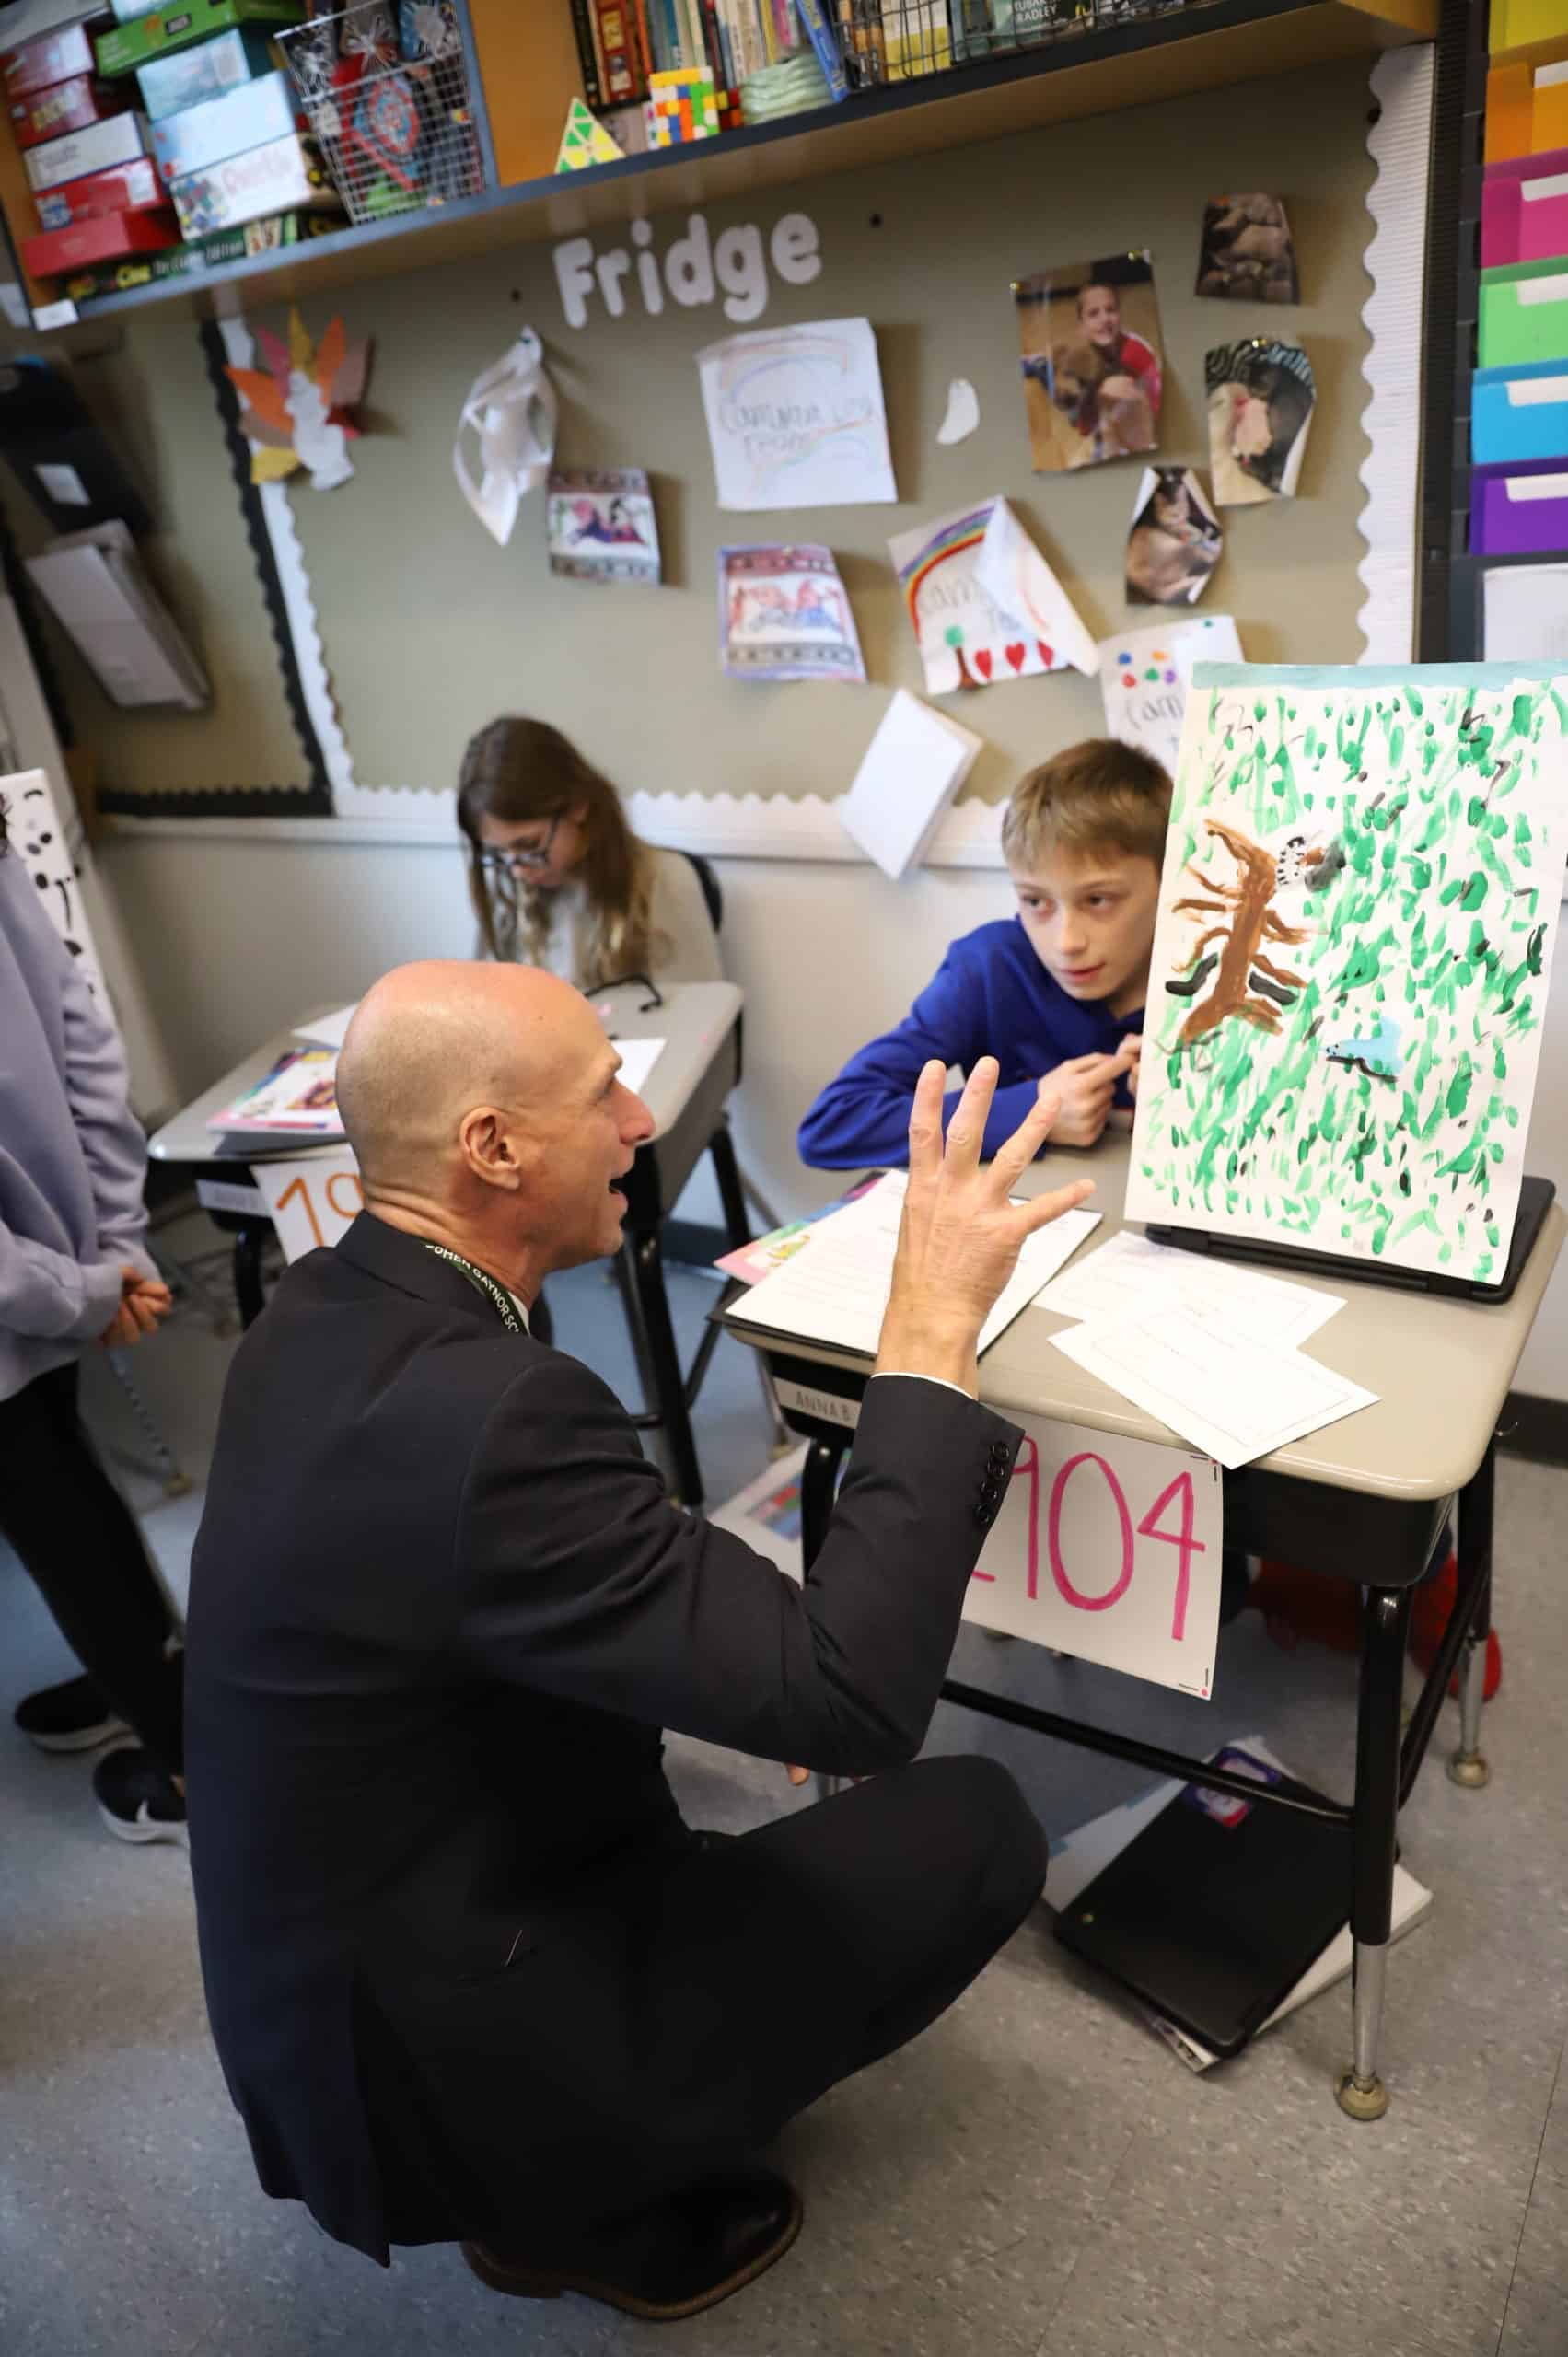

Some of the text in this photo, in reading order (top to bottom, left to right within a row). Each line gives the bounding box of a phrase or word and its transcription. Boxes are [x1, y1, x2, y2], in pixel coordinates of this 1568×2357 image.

[1016, 5, 1059, 23] RADLEY
[554, 212, 822, 329] Fridge
[425, 1244, 520, 1334] OHEN GAYNOR SC
[972, 1435, 1206, 1641] 904
